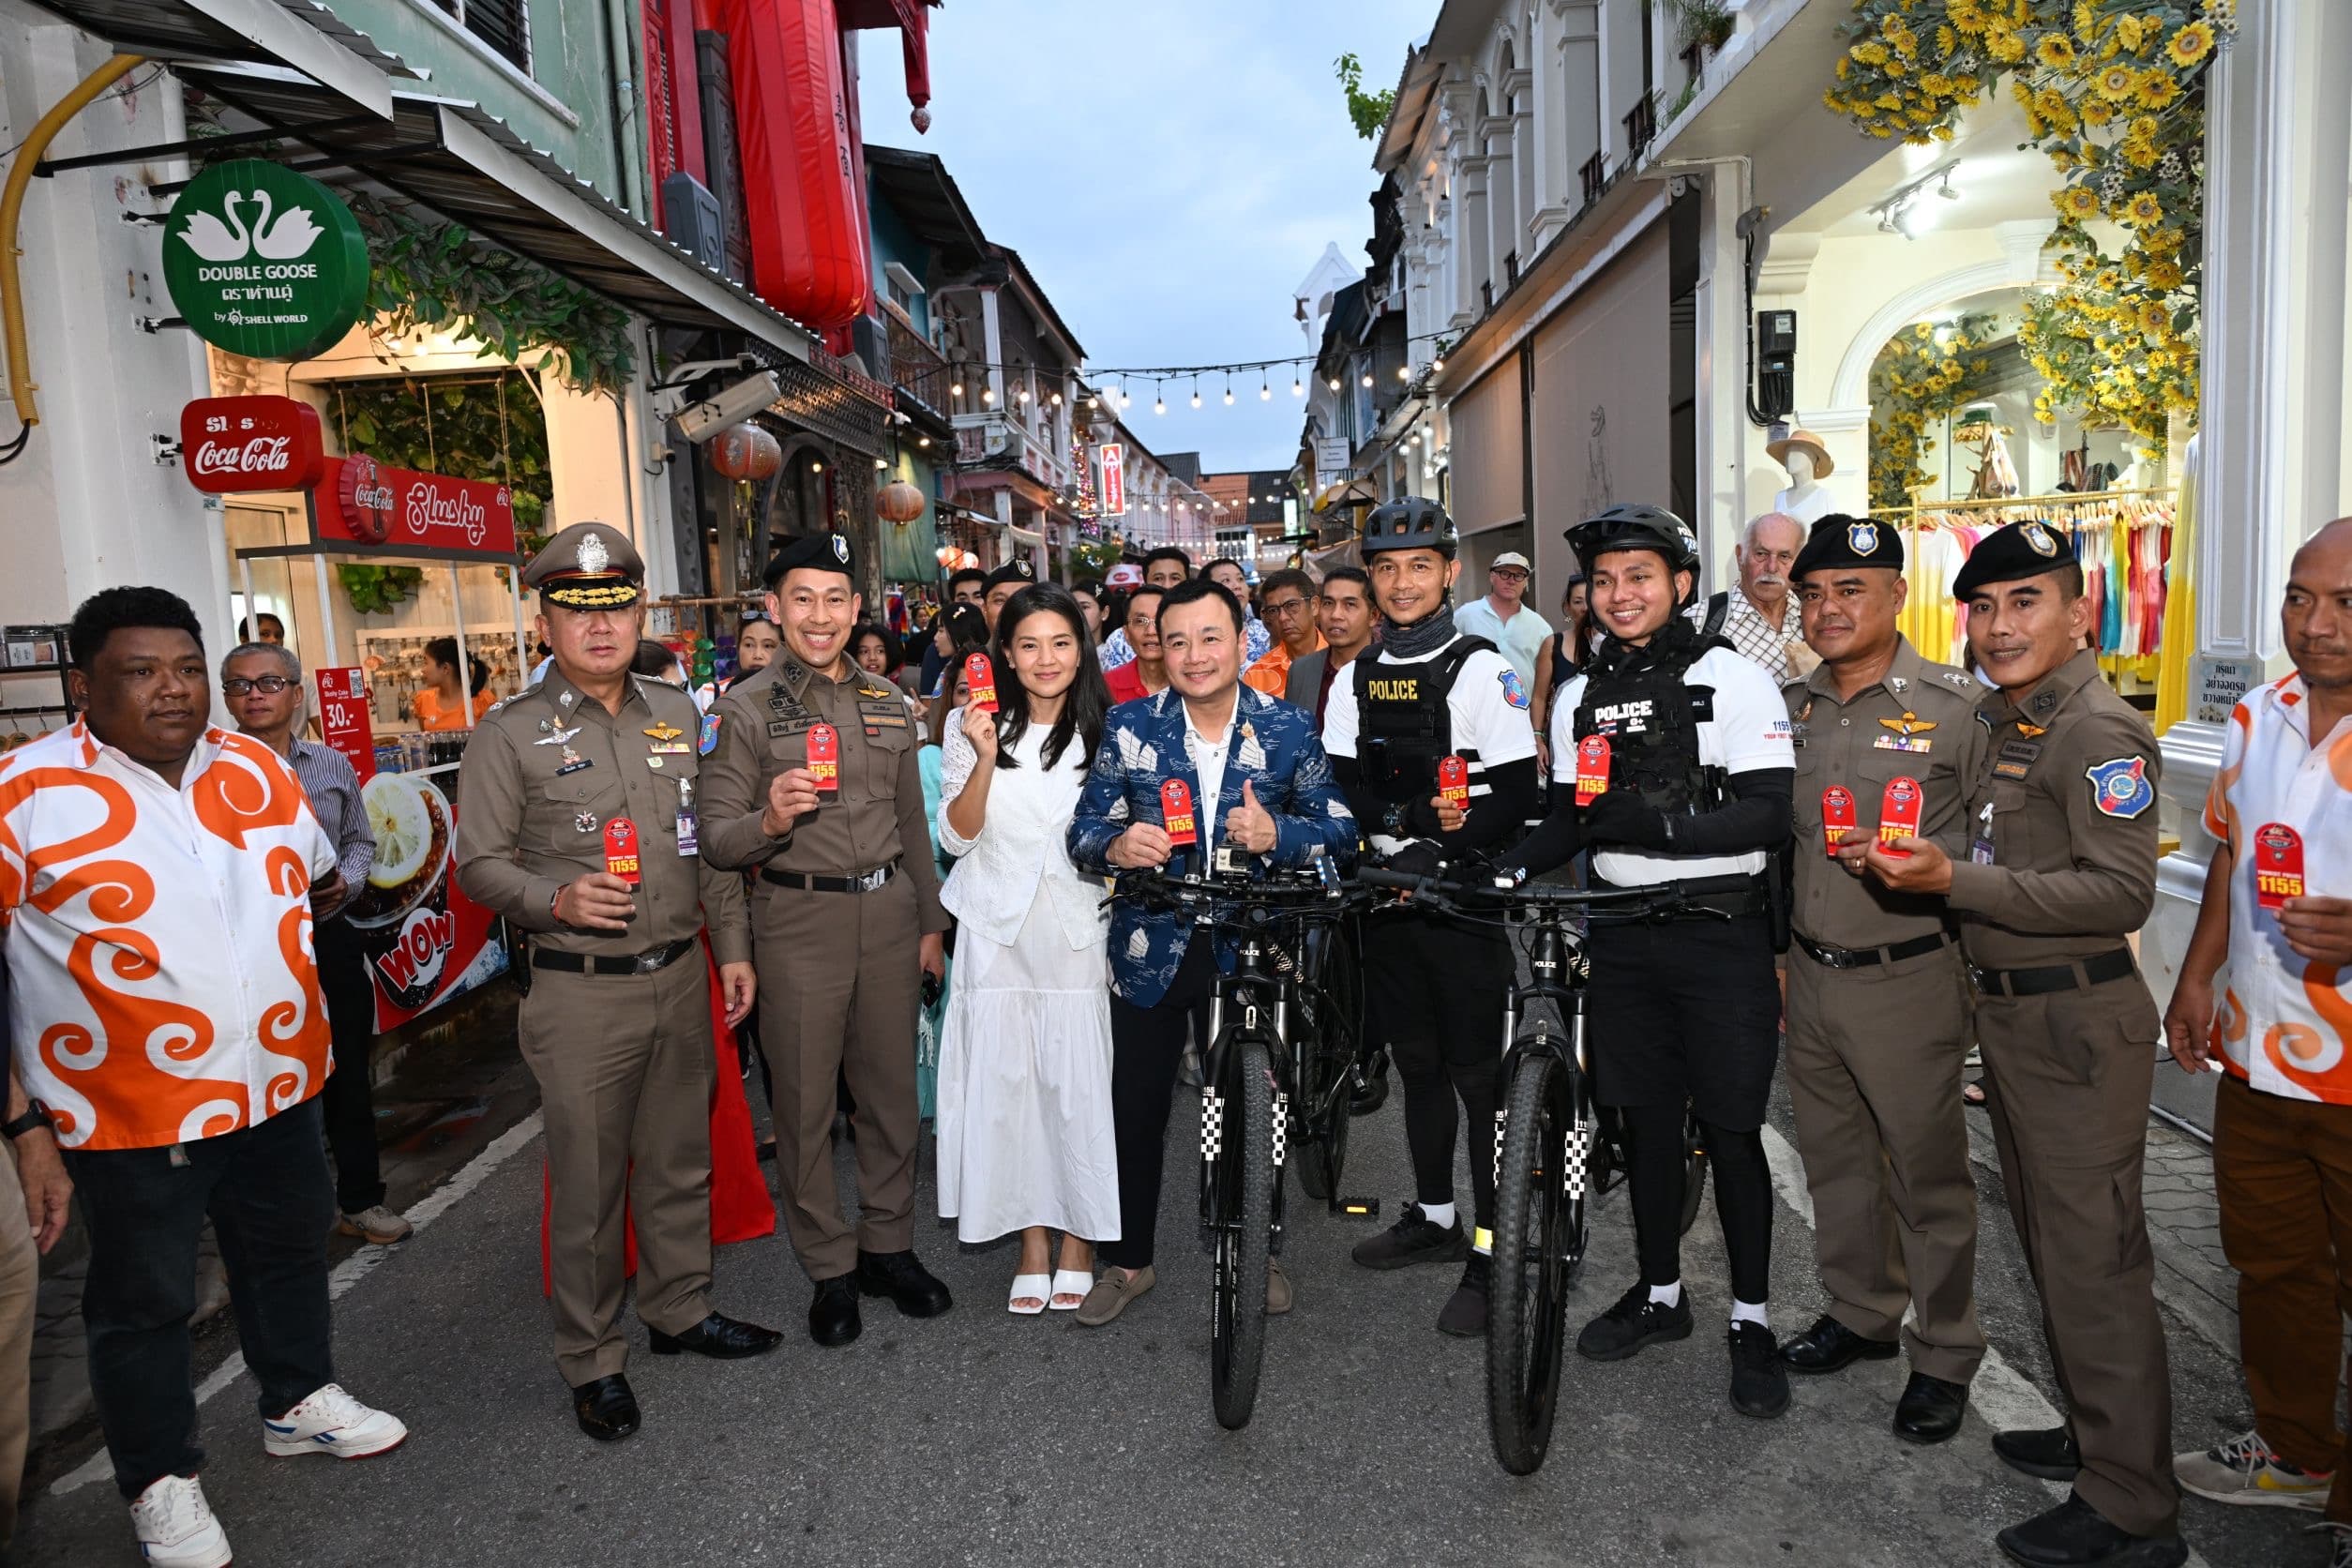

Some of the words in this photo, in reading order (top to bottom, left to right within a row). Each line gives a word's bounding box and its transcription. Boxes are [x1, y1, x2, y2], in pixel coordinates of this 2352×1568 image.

[198, 265, 263, 282] DOUBLE
[264, 264, 318, 279] GOOSE
[221, 283, 294, 302] ตราห่านคู่
[214, 311, 226, 323] by
[245, 315, 273, 324] SHELL
[273, 314, 309, 324] WORLD
[406, 481, 487, 546] Slushy
[2215, 664, 2236, 676] กรุณา
[1368, 679, 1418, 701] POLICE
[2206, 675, 2246, 692] อย่าจอดรถ
[1594, 700, 1653, 723] POLICE
[1772, 721, 1790, 731] 1155
[809, 764, 837, 777] 1155
[1577, 778, 1606, 794] 1155
[1441, 788, 1468, 801] 1155
[1168, 817, 1194, 833] 1155
[608, 859, 639, 874] 1155
[2257, 875, 2303, 897] 1155
[376, 909, 455, 993] WOW
[1534, 960, 1557, 969] POLICE
